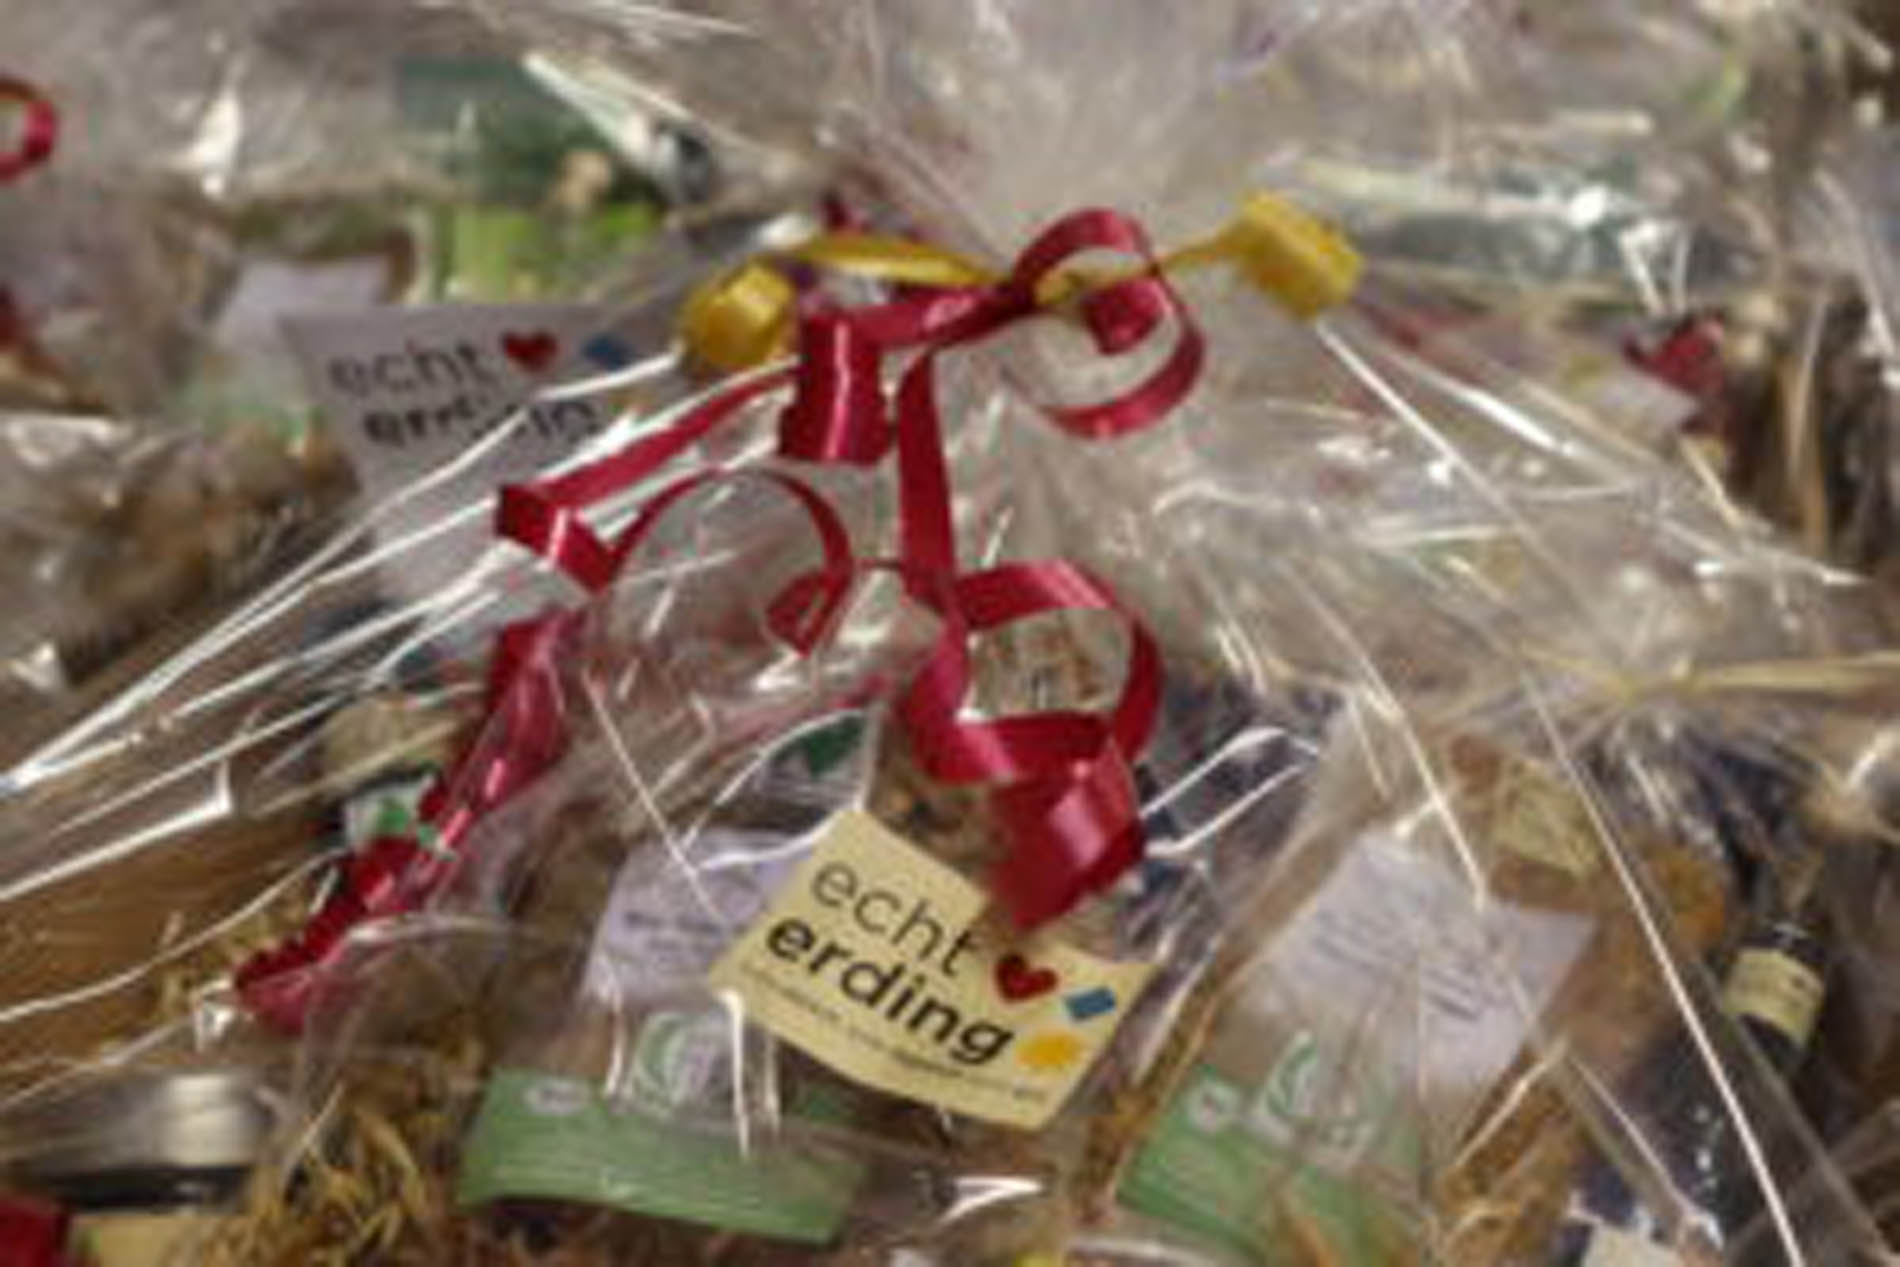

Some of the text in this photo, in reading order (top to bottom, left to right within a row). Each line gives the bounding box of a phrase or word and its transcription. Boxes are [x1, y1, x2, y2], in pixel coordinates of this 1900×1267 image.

[330, 341, 494, 397] echt
[811, 857, 981, 979] echt
[767, 915, 1015, 1067] erding
